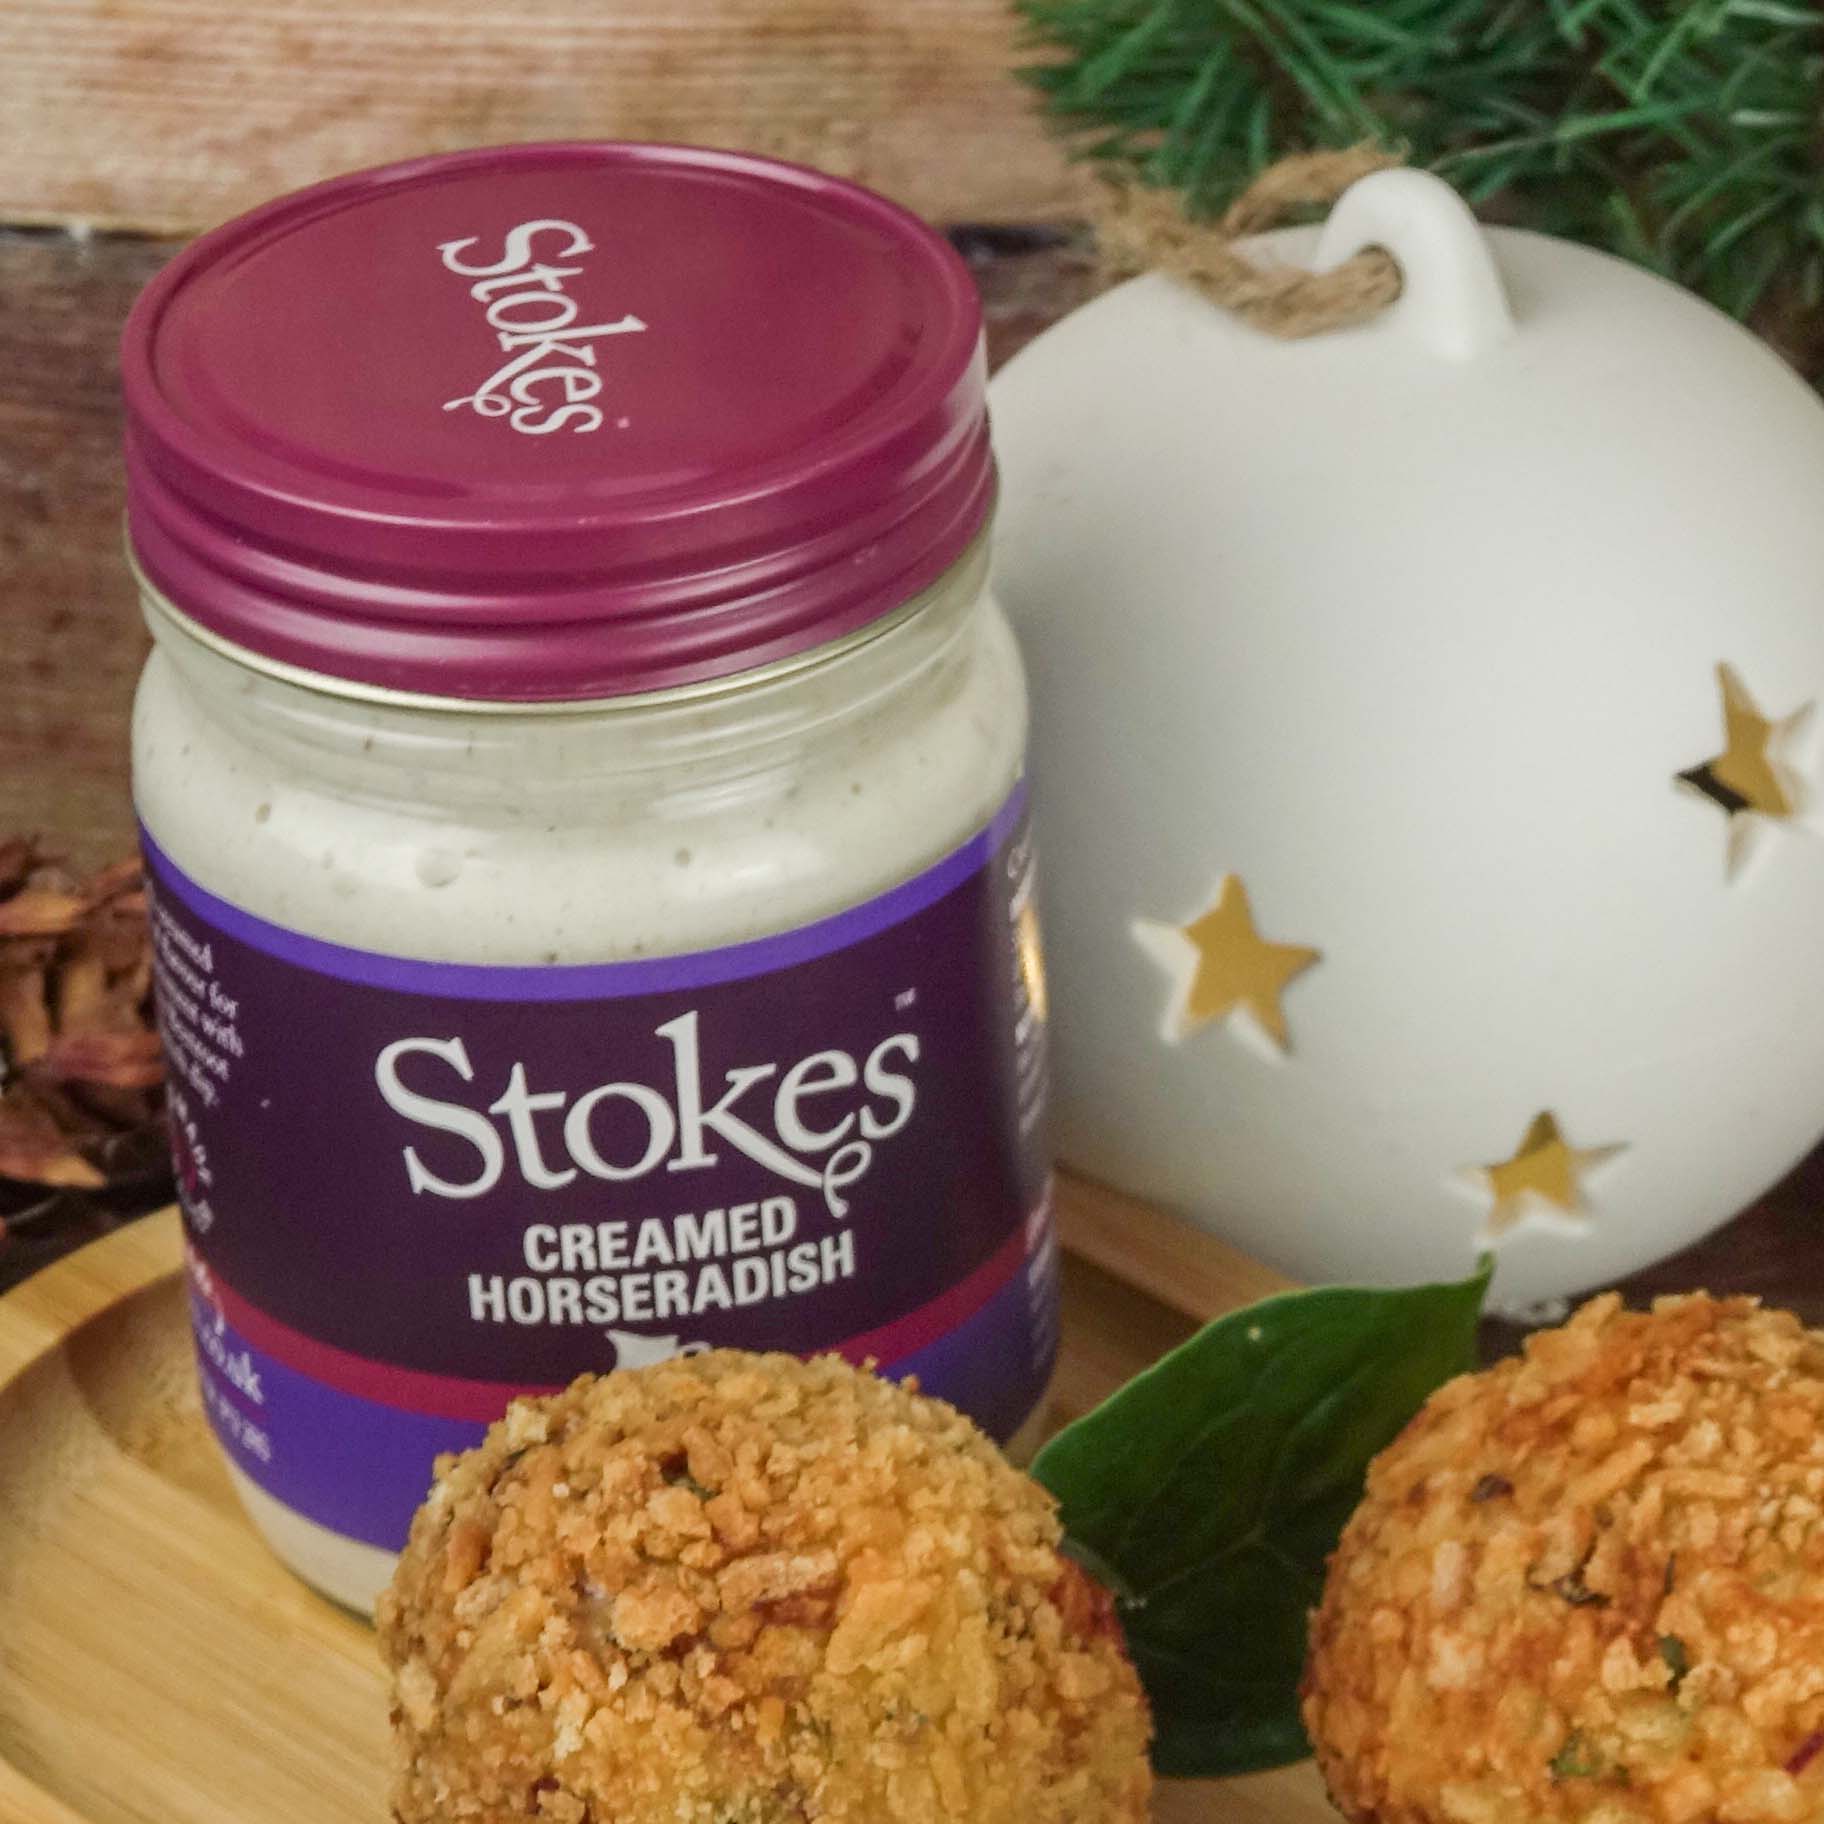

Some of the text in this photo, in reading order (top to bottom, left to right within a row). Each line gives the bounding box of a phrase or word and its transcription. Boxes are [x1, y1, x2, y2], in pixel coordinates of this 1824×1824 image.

[435, 218, 649, 435] Stokes
[374, 1009, 921, 1219] Stokes
[467, 1229, 856, 1325] HORSERADISH
[522, 1196, 798, 1274] CREAMED
